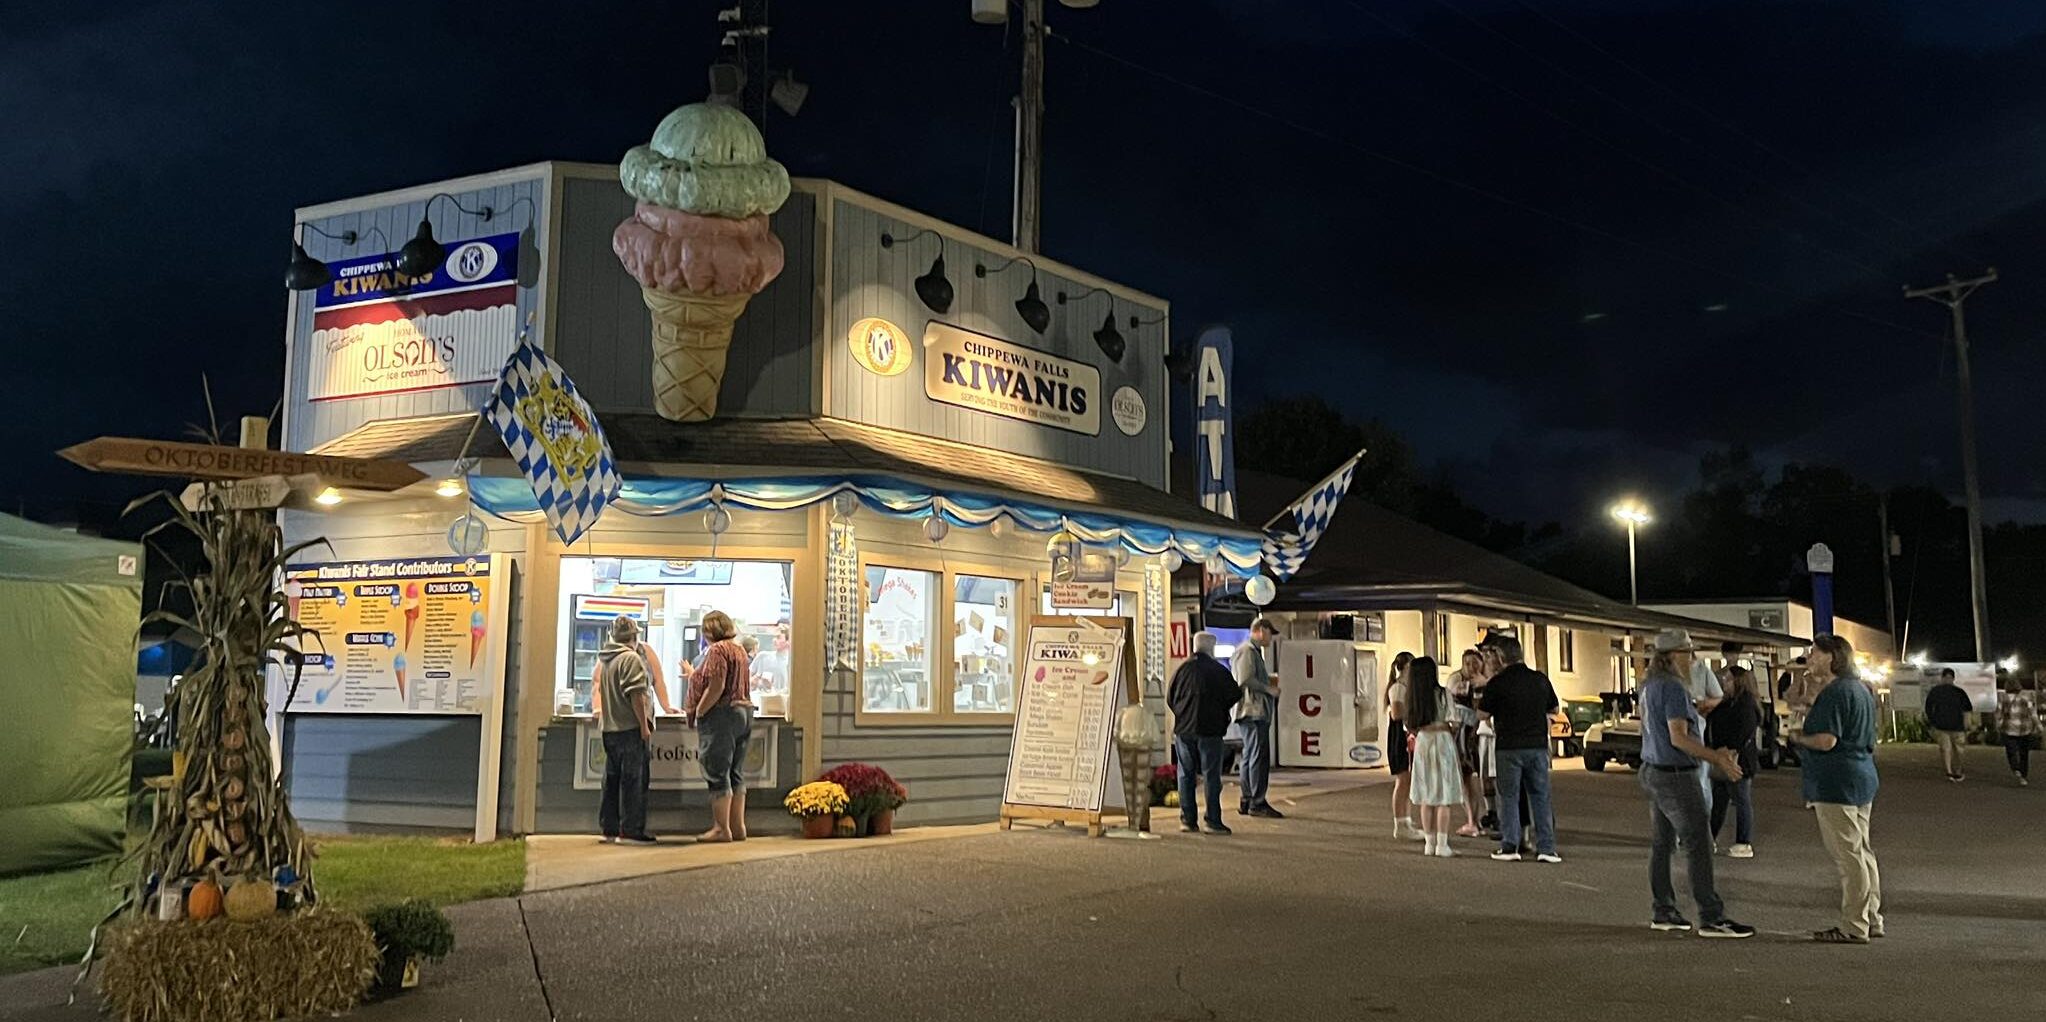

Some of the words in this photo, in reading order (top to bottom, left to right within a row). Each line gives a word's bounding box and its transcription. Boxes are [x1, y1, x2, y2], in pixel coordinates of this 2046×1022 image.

[341, 258, 393, 278] CHIPPEWA
[386, 370, 399, 381] ice
[401, 367, 428, 380] cream
[963, 341, 1030, 371] CHIPPEWA
[1034, 359, 1069, 381] FALLS
[942, 353, 1088, 416] KIWANIS
[144, 447, 308, 477] OKTOBERFEST
[315, 458, 369, 481] WEG
[318, 565, 352, 579] Kiwanis
[352, 564, 370, 578] Fair
[369, 562, 396, 577] Stand
[396, 560, 453, 576] Contributors
[1040, 649, 1107, 661] KIWAS
[1299, 654, 1322, 757] ICE
